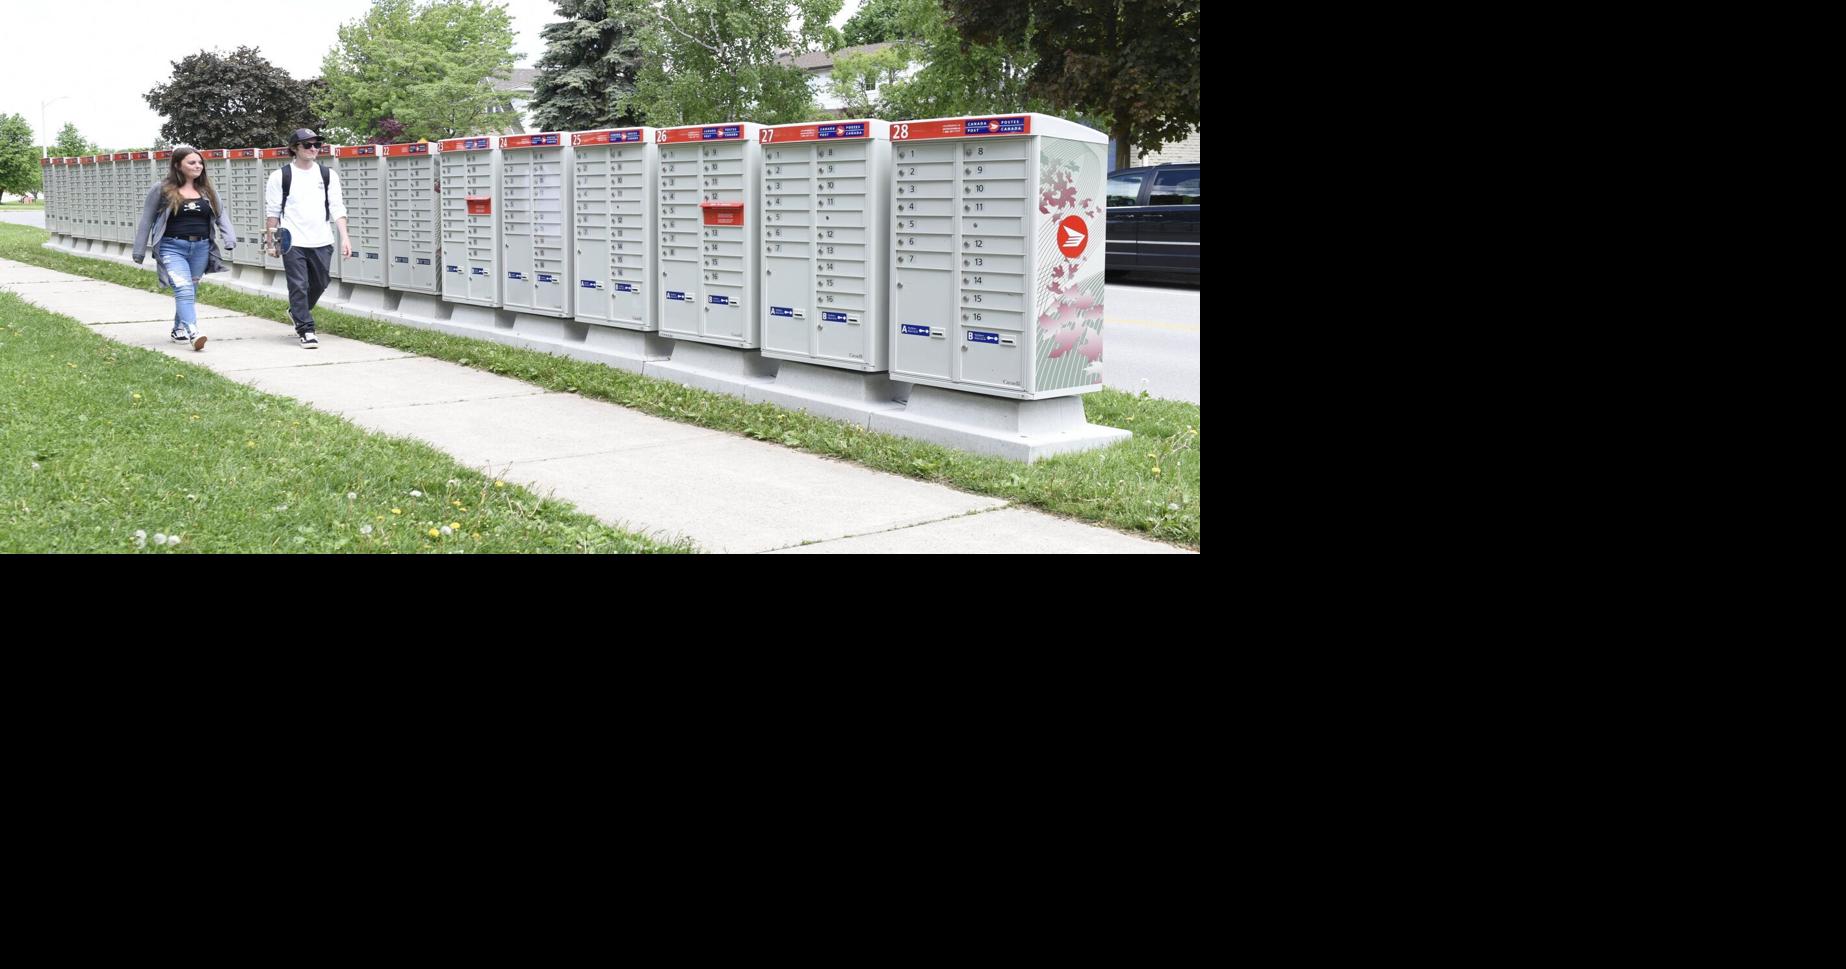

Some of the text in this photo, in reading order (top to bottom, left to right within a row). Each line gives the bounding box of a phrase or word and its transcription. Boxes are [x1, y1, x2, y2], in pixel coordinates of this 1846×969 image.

[657, 130, 667, 142] 26
[762, 129, 774, 142] 27
[892, 124, 908, 139] 28
[500, 138, 507, 148] 24
[573, 135, 581, 145] 25
[383, 147, 389, 155] 22
